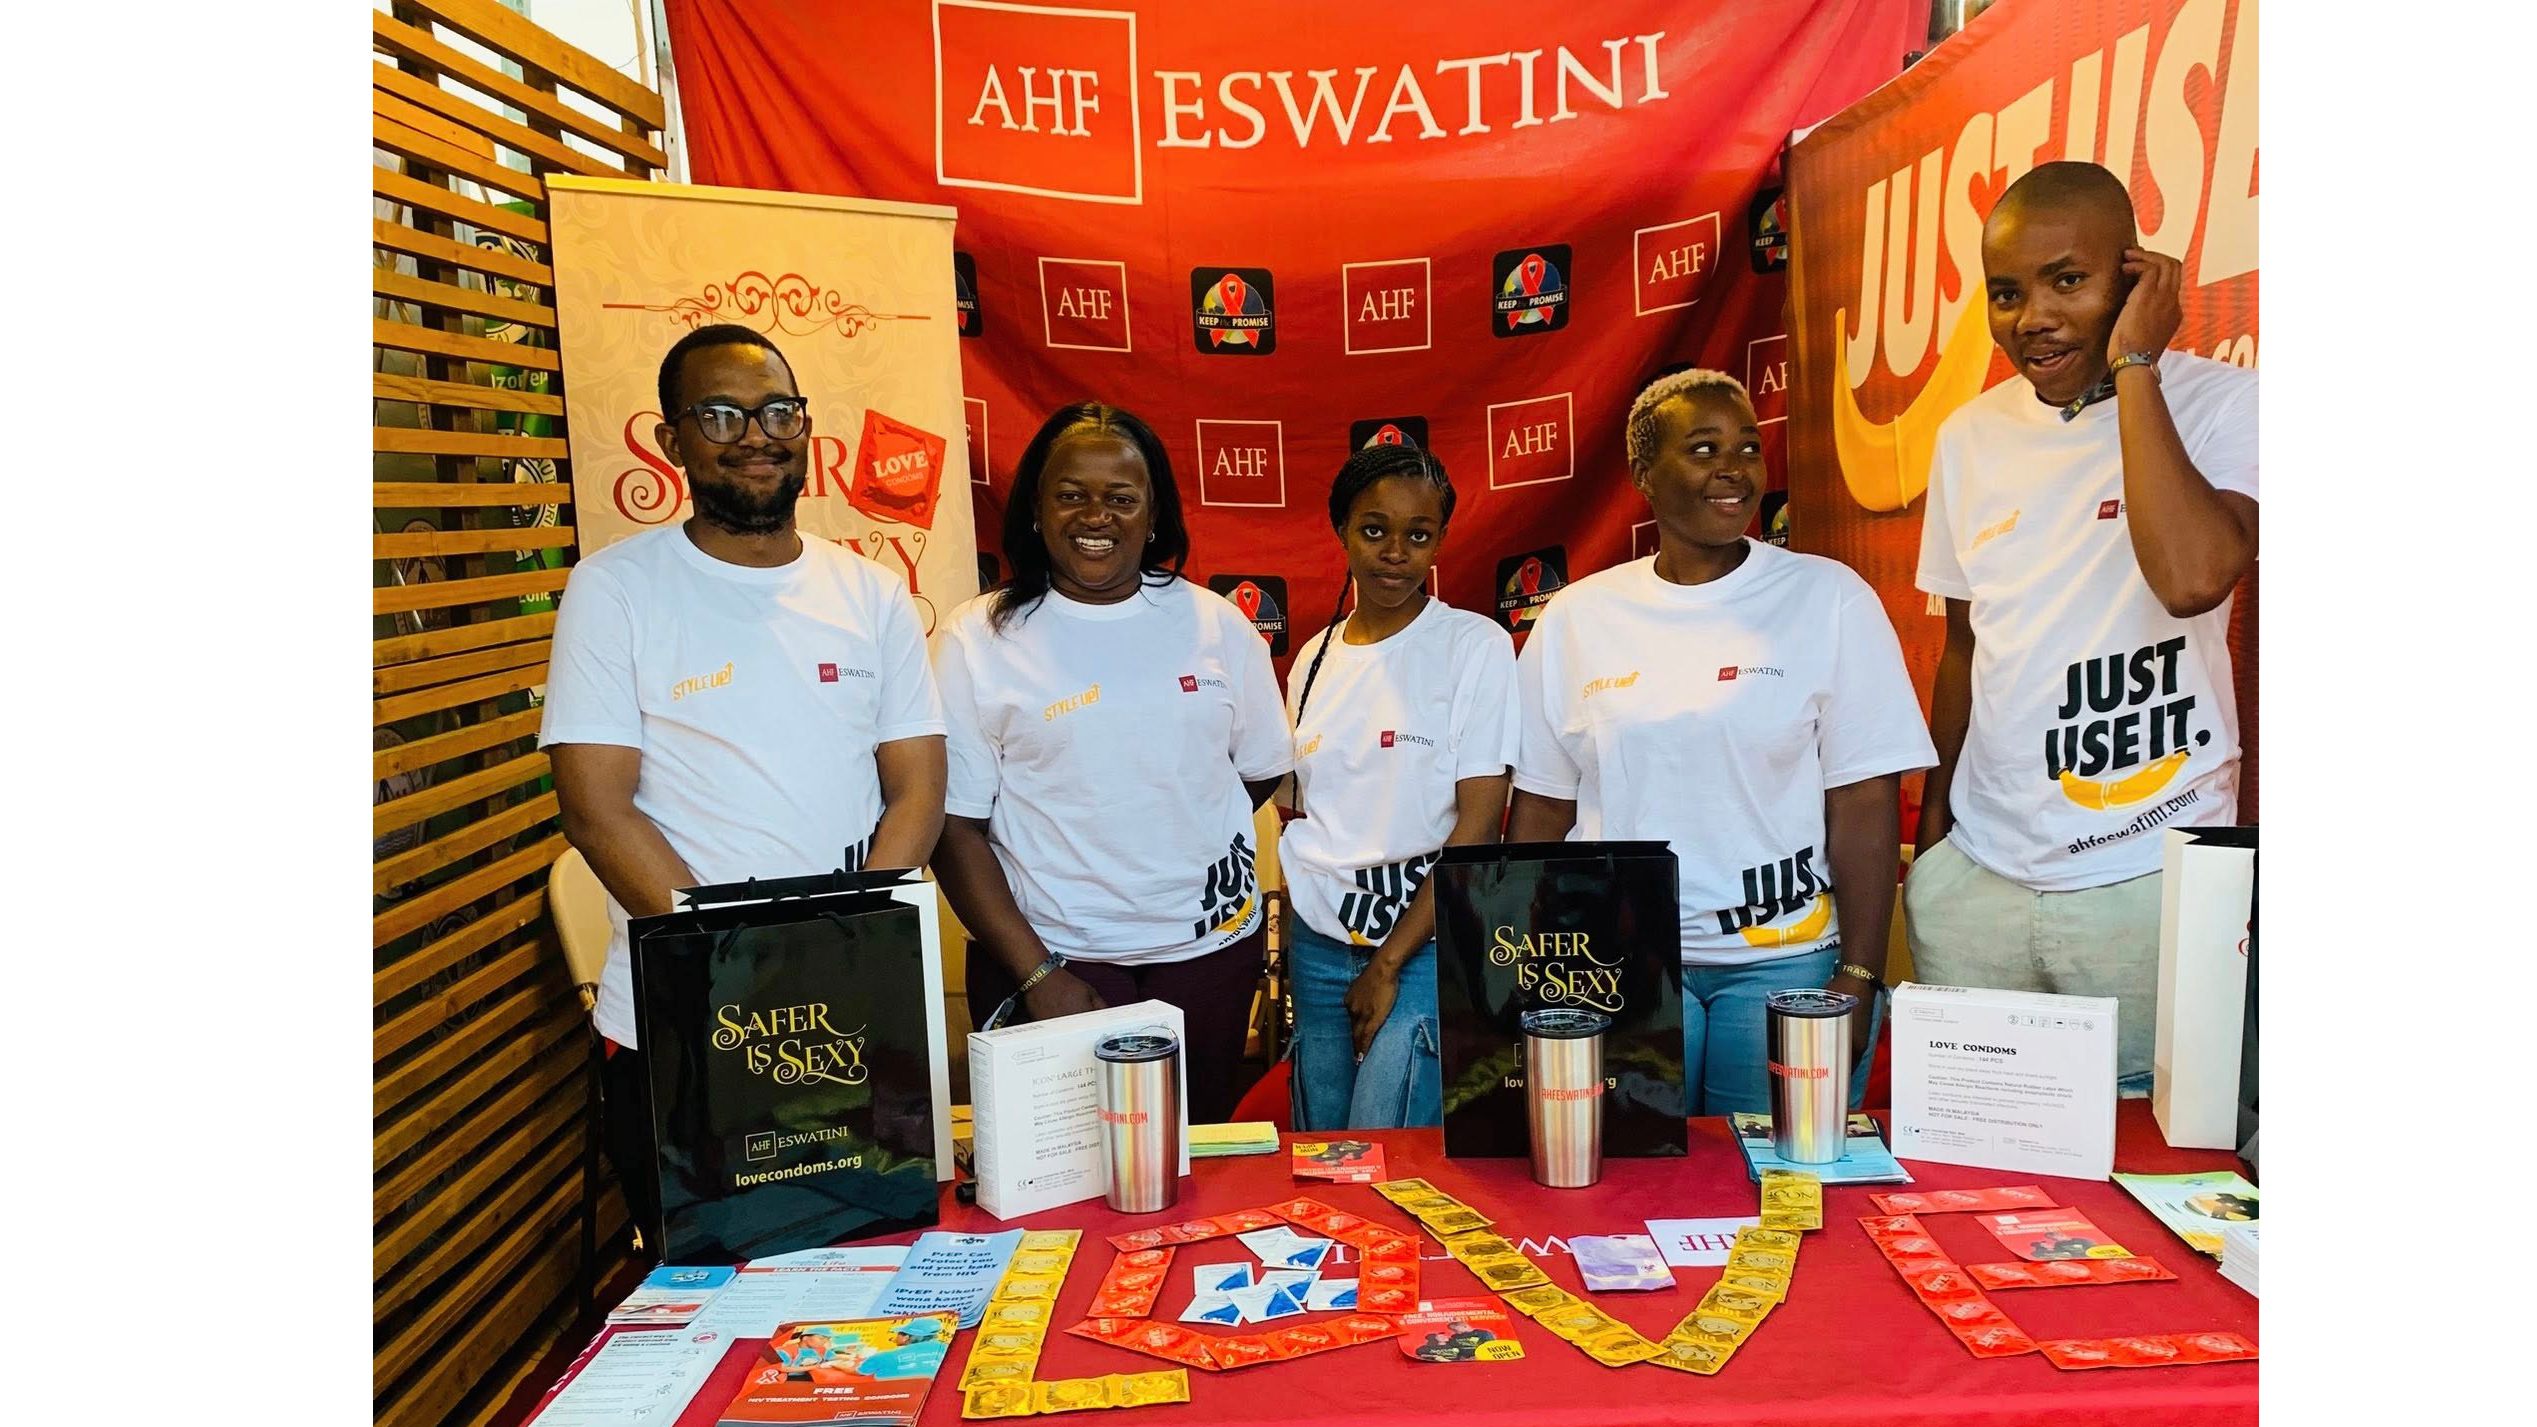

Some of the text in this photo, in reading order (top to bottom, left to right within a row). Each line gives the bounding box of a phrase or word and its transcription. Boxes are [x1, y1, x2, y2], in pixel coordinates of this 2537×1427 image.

[968, 31, 1669, 148] AHF ESWATINI
[1648, 242, 1705, 284] AHF
[1057, 287, 1112, 320] AHF
[1358, 287, 1415, 322] AHF
[1498, 292, 1564, 310] KEEP PROMISE
[1199, 316, 1219, 326] KEEP
[1232, 317, 1269, 327] PROMISE
[1503, 423, 1558, 459] AHF
[872, 450, 928, 478] LOVE
[1213, 448, 1267, 477] AHF
[1500, 600, 1517, 609] KEEP
[822, 668, 875, 679] AHF ESWATINI
[1721, 667, 1784, 678] AHF ESWATINI
[2059, 636, 2187, 720] JUST
[673, 674, 707, 701] STYLE
[1584, 678, 1613, 698] STYLE
[1044, 695, 1078, 722] STYLE
[1395, 734, 1434, 748] ESWATINI
[2045, 714, 2140, 781] USE
[1490, 925, 1624, 967] SAFER
[1518, 961, 1624, 1012] IS SEXY
[712, 1002, 867, 1051] SAFER
[747, 1037, 868, 1085] IS SEXY
[1929, 1041, 2017, 1055] LOVE CONDOMS
[751, 1126, 848, 1153] AHF ESWATINI
[736, 1155, 862, 1187] lovecondoms.org
[1488, 1345, 1511, 1353] NOW
[1493, 1352, 1520, 1360] OPEN
